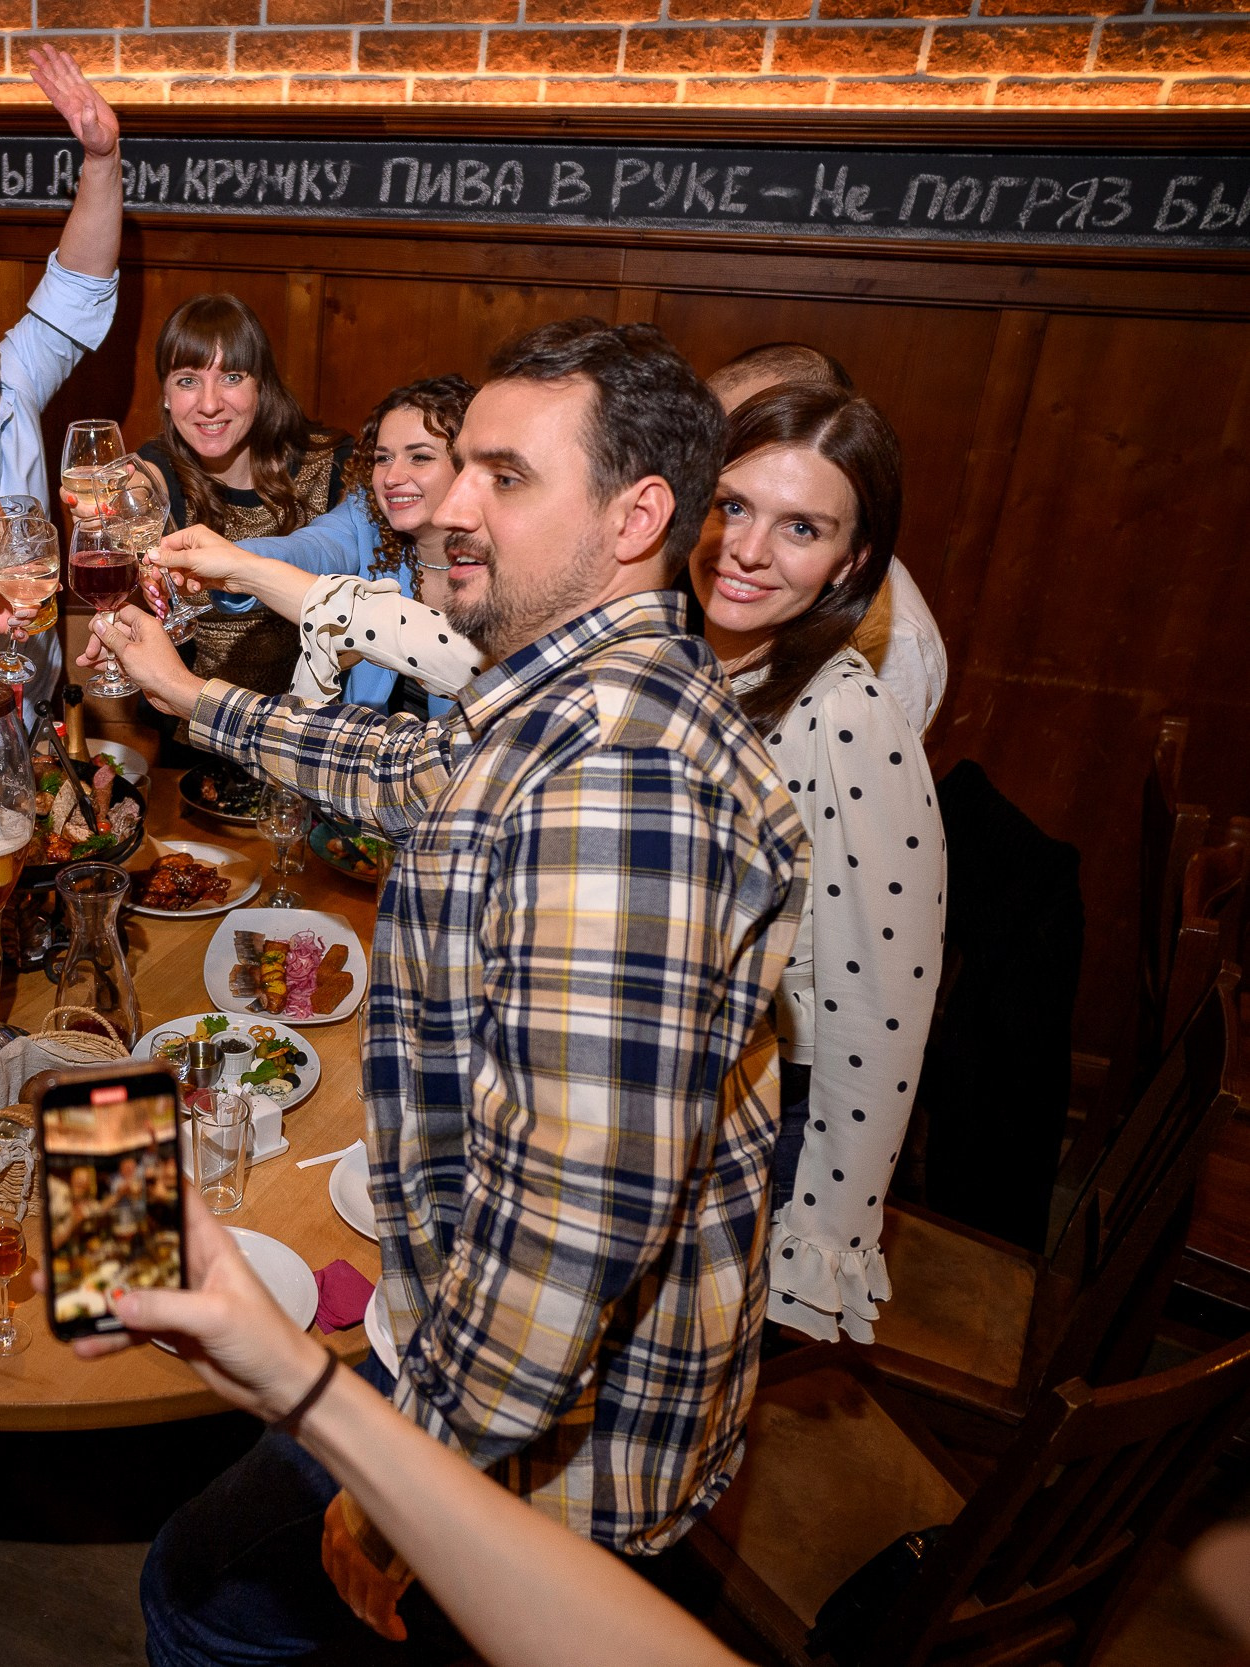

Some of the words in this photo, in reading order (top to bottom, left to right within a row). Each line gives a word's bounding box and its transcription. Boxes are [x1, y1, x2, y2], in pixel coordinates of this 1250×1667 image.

[182, 156, 352, 203] КРУЖКУ
[379, 157, 524, 206] ПИВА
[549, 160, 591, 207] В
[611, 158, 753, 213] РУКЕ
[898, 173, 1132, 229] ПОГРЯЗ
